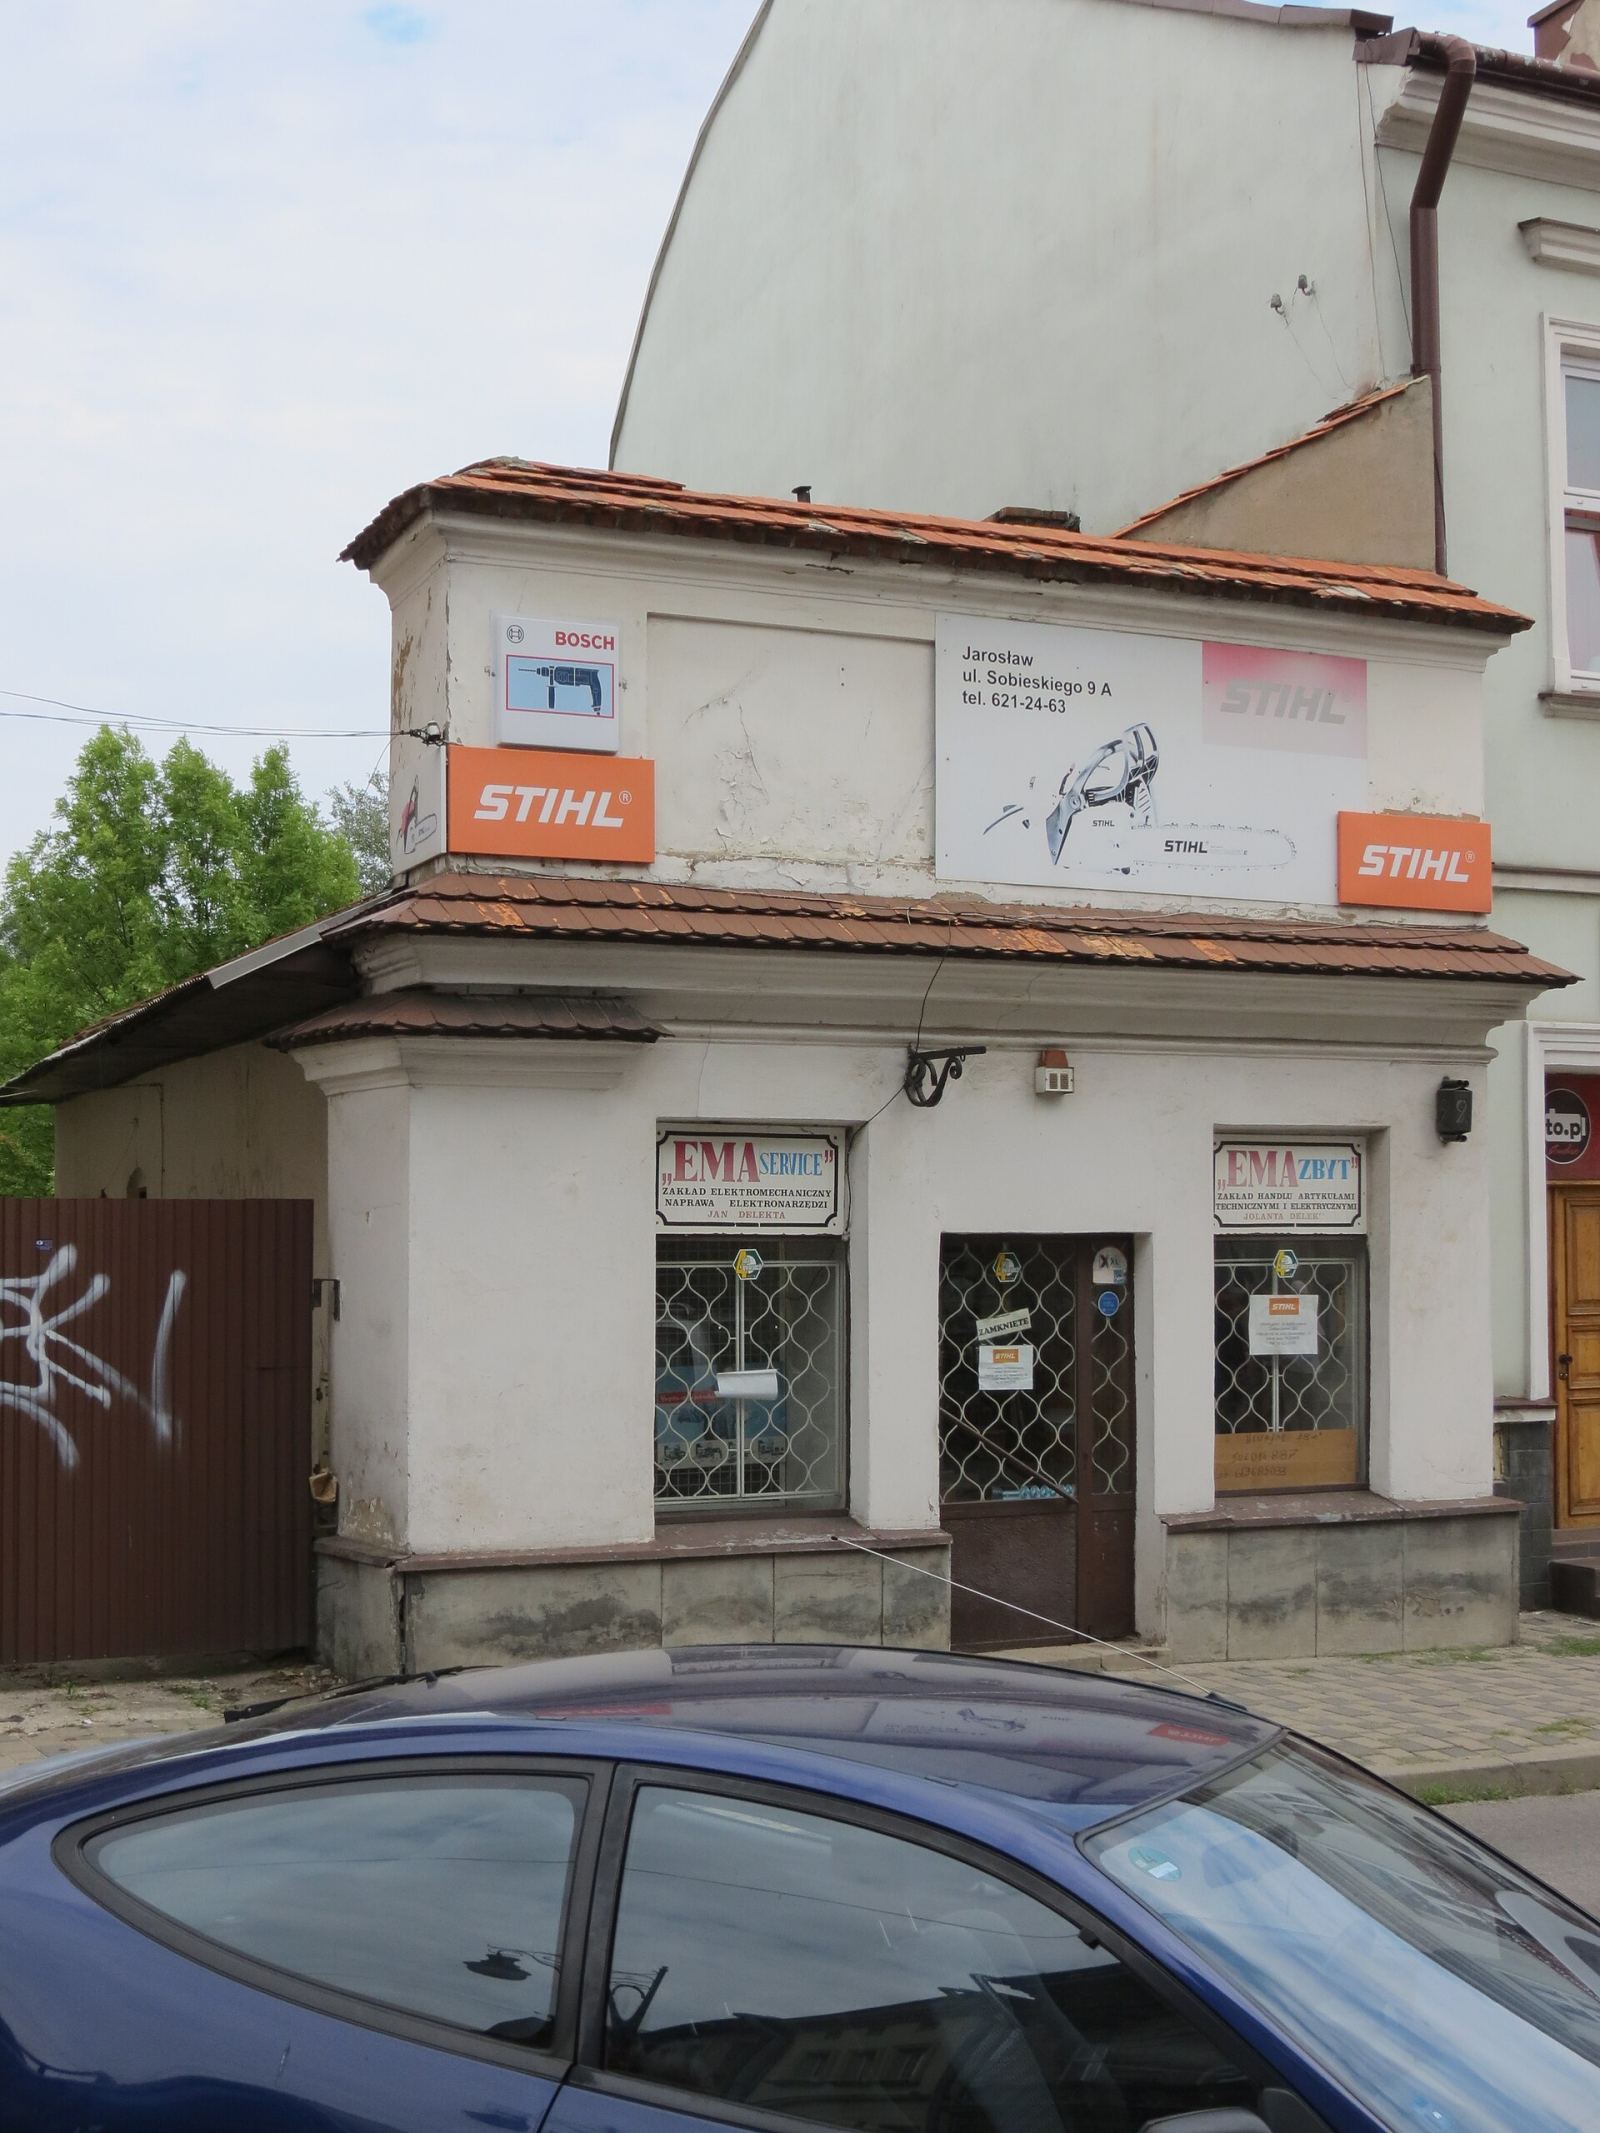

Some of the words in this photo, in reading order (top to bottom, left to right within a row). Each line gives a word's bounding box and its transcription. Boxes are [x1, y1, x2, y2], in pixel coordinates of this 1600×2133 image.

[555, 631, 615, 650] BOSCH
[962, 646, 1034, 667] Jarosław
[962, 669, 982, 684] ul.
[987, 670, 1083, 696] Sobieskiego
[1087, 681, 1096, 695] 9
[1101, 682, 1113, 697] A
[962, 690, 986, 706] tel.
[991, 692, 1067, 714] 621-24-63
[1220, 679, 1346, 725] STIHL
[1092, 819, 1116, 827] STIHL
[1164, 840, 1208, 853] STIHL
[1545, 1116, 1586, 1139] to.pl
[662, 1187, 707, 1196] ZAKŁAD
[711, 1188, 832, 1198] ELEKTROMECHANICZNY
[1217, 1192, 1254, 1200] ZAKŁAD
[1257, 1192, 1293, 1200] HANDLU
[1298, 1192, 1355, 1200] ARTYKUŁAMI
[665, 1198, 715, 1207] NAPRAWA
[1216, 1202, 1279, 1210] TECHNICZNYMI
[1290, 1202, 1357, 1210] ELEKTRYCZNYMI
[707, 1210, 728, 1219] JAN
[738, 1210, 786, 1220] DELEKTA
[1243, 1212, 1284, 1221] JOLANTA
[1271, 1303, 1296, 1311] STIHL
